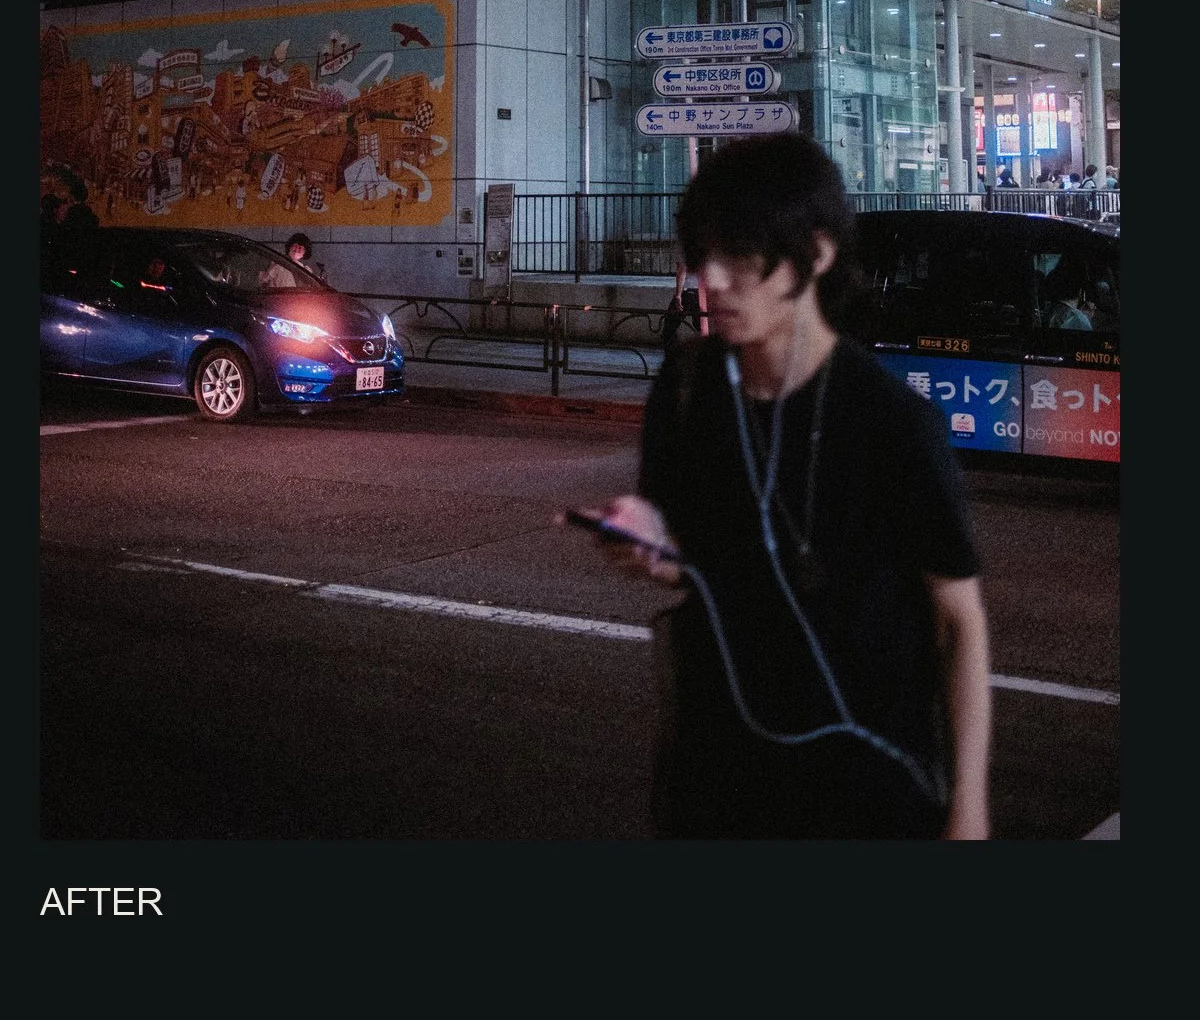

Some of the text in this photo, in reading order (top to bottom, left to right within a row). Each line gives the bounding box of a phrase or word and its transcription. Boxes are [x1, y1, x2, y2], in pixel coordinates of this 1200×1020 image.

[667, 28, 759, 43] 東京都第三建設事務所
[645, 46, 663, 54] 190m
[685, 69, 742, 82] 中野区役所
[710, 84, 721, 93] City
[669, 108, 783, 122] 中野サンプラザ
[944, 338, 969, 351] 326
[1075, 351, 1111, 364] SHINTO
[993, 421, 1021, 437] GO
[1026, 424, 1084, 444] beyond
[1090, 429, 1120, 447] NO
